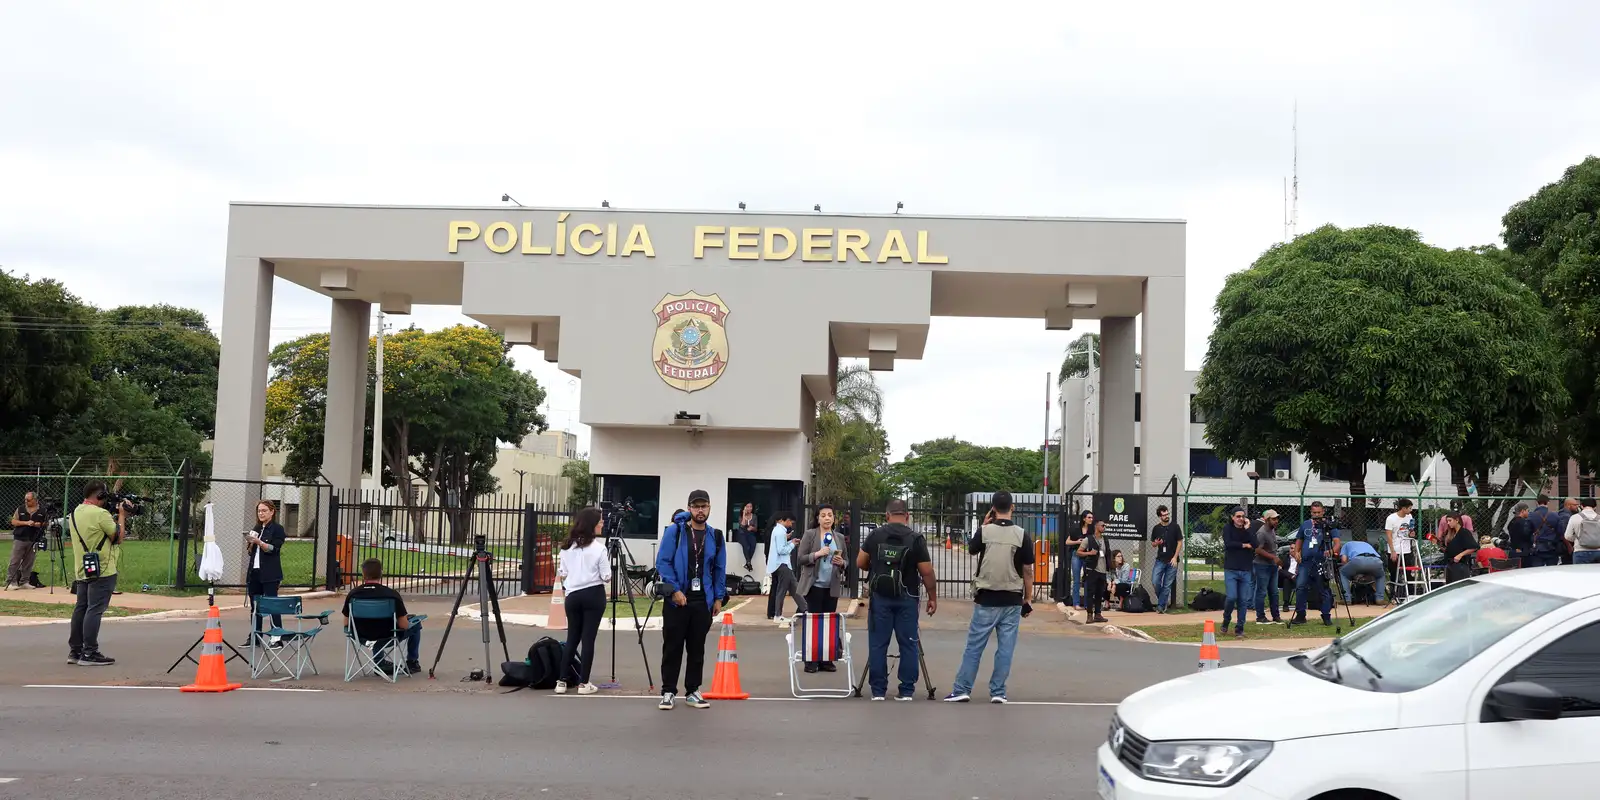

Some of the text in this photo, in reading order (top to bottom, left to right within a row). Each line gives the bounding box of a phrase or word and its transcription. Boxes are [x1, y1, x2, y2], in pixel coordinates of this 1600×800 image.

[447, 212, 949, 264] POLÍCIA FEDERAL
[664, 365, 716, 379] FEDERAL
[1109, 514, 1129, 522] PARE
